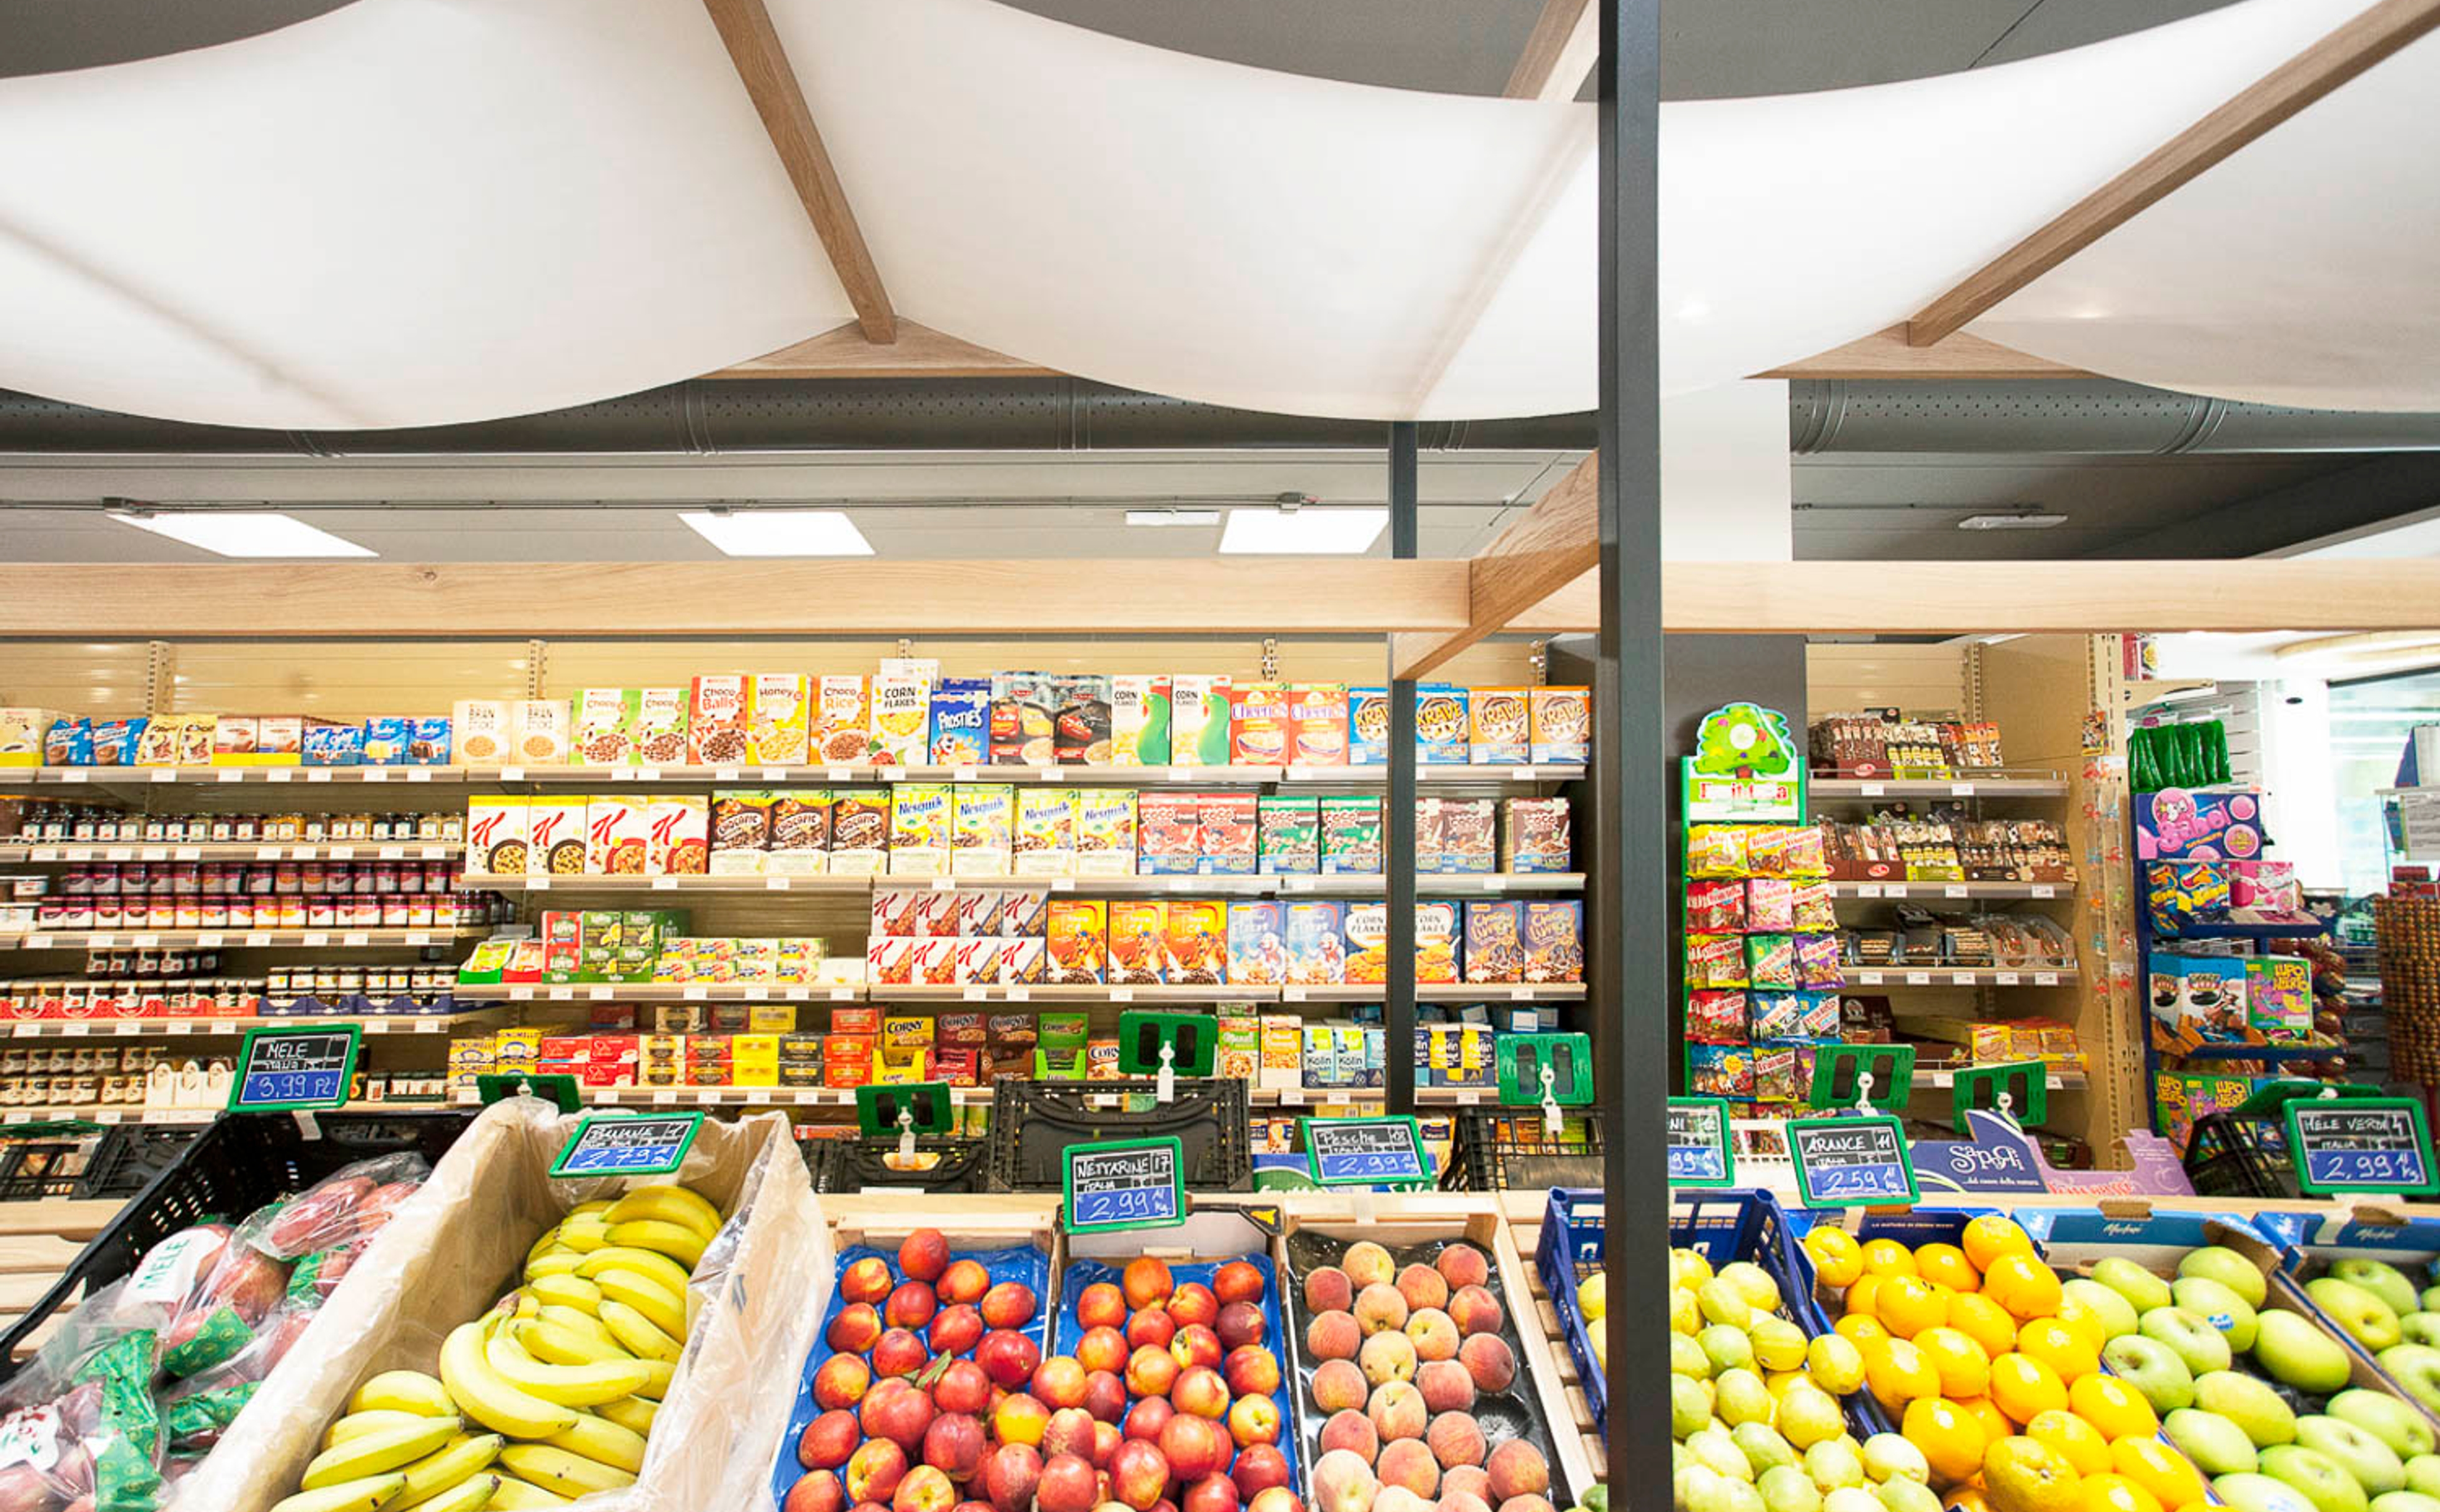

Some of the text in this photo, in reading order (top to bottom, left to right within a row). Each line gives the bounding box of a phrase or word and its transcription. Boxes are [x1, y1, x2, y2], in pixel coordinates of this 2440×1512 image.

[703, 688, 735, 698] Choco
[824, 688, 856, 696] Choco
[885, 687, 916, 699] CORN
[1114, 690, 1138, 700] CORN
[1176, 690, 1198, 700] CORN
[645, 699, 674, 708] Choco
[703, 698, 735, 710] Balls
[825, 697, 855, 710] Rice
[883, 698, 916, 709] FLAKES
[899, 796, 943, 816] Nesquik
[472, 811, 505, 847] K
[533, 811, 565, 847] K
[591, 808, 627, 845] K
[651, 808, 687, 845] K
[874, 892, 898, 918] K
[918, 893, 941, 918] K
[961, 893, 985, 919] K
[1004, 894, 1028, 919] K
[1416, 916, 1441, 924] ORN
[870, 940, 893, 966] K
[914, 941, 937, 966] K
[958, 941, 981, 966] K
[1001, 941, 1024, 966] K
[2274, 964, 2304, 977] LUPO
[887, 1020, 925, 1034] CORNY
[940, 1014, 978, 1028] CORNY
[989, 1015, 1029, 1029] CORNY
[266, 1041, 309, 1059] MELE
[259, 1074, 307, 1099] 3,99
[2216, 1081, 2246, 1094] LUPO
[2304, 1117, 2341, 1132] MELE
[2393, 1114, 2404, 1136] 4
[1319, 1129, 1378, 1146] Pesche
[1806, 1135, 1866, 1154] ARANCE
[2321, 1140, 2358, 1150] ITALIA
[1078, 1155, 1171, 1178] NETTARINE 17
[1337, 1155, 1400, 1175] 2,99
[2324, 1155, 2394, 1180] 2,99
[1823, 1170, 1878, 1195] 2,59
[1089, 1191, 1149, 1220] 2,99
